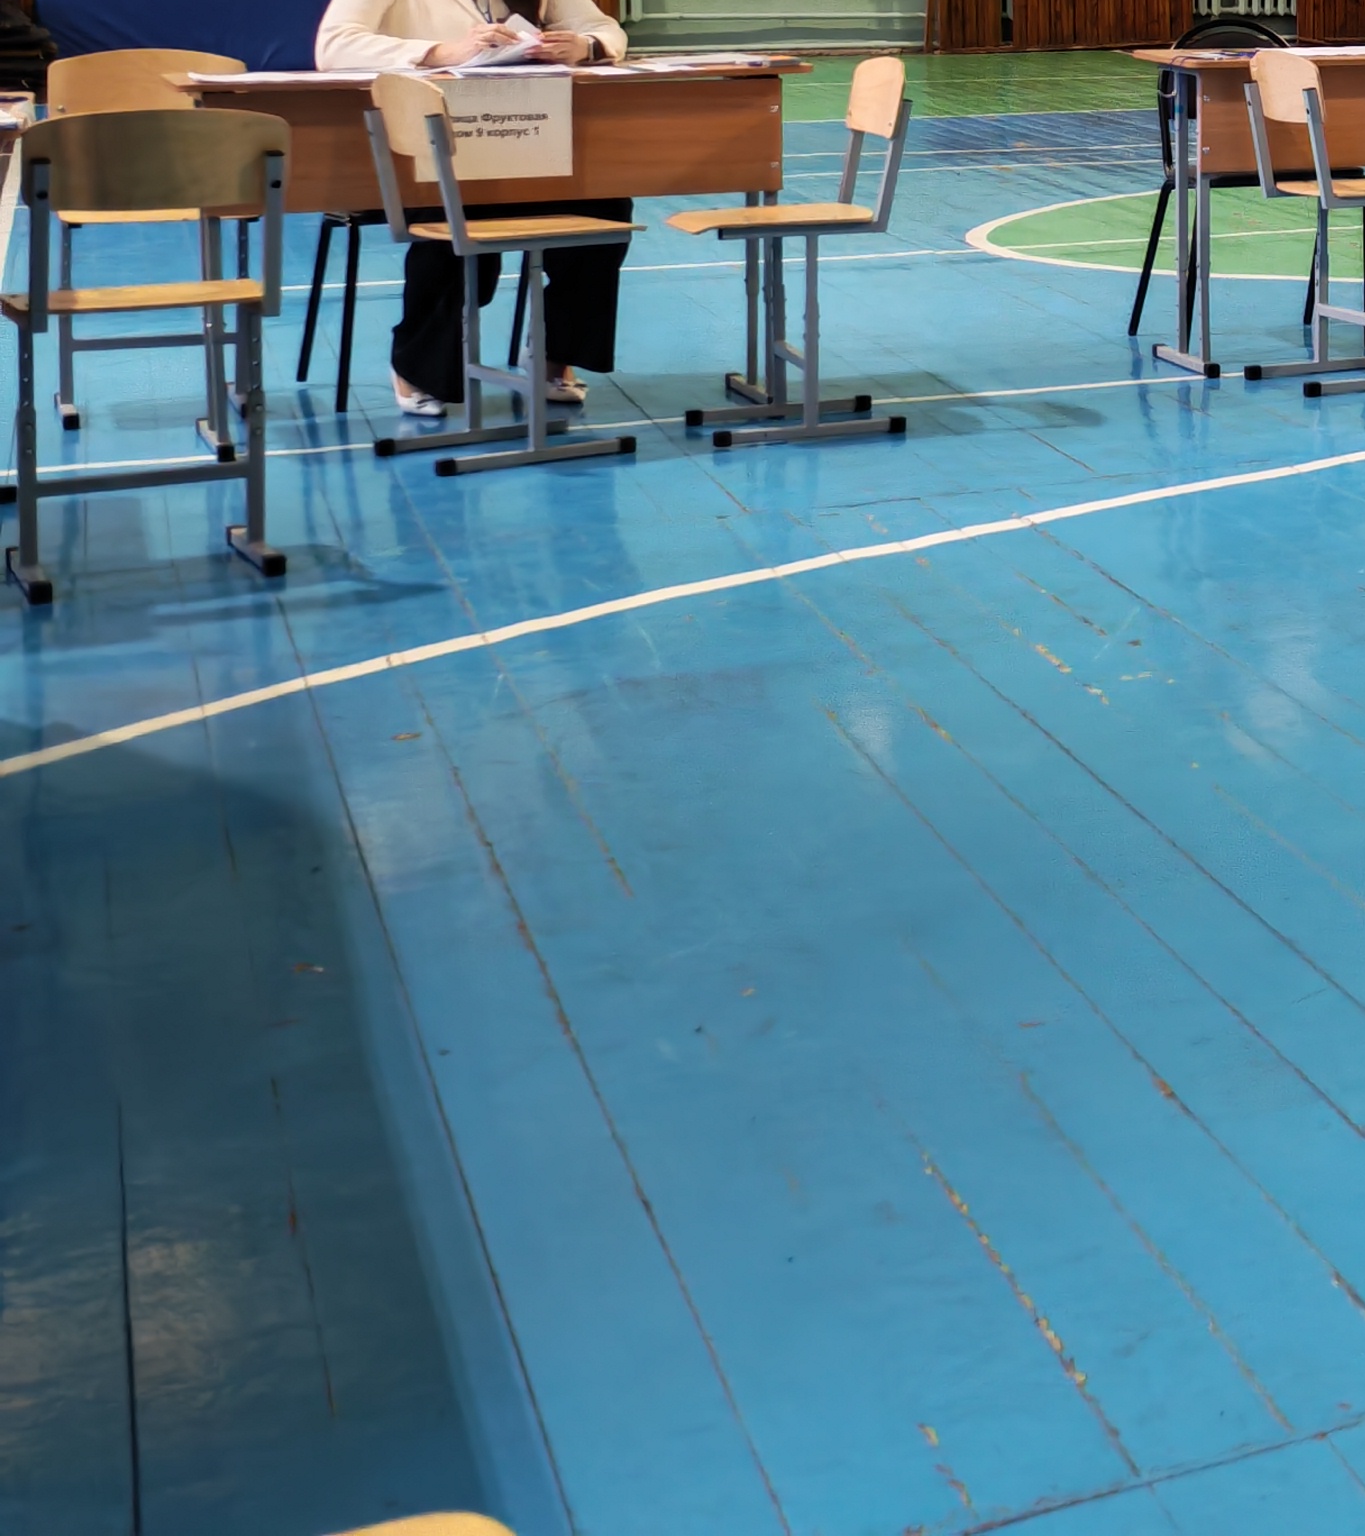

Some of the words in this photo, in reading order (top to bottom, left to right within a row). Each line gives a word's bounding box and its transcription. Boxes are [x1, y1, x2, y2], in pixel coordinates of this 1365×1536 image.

[481, 112, 548, 124] Фруктовая
[454, 130, 473, 138] ом
[487, 128, 530, 138] корпус
